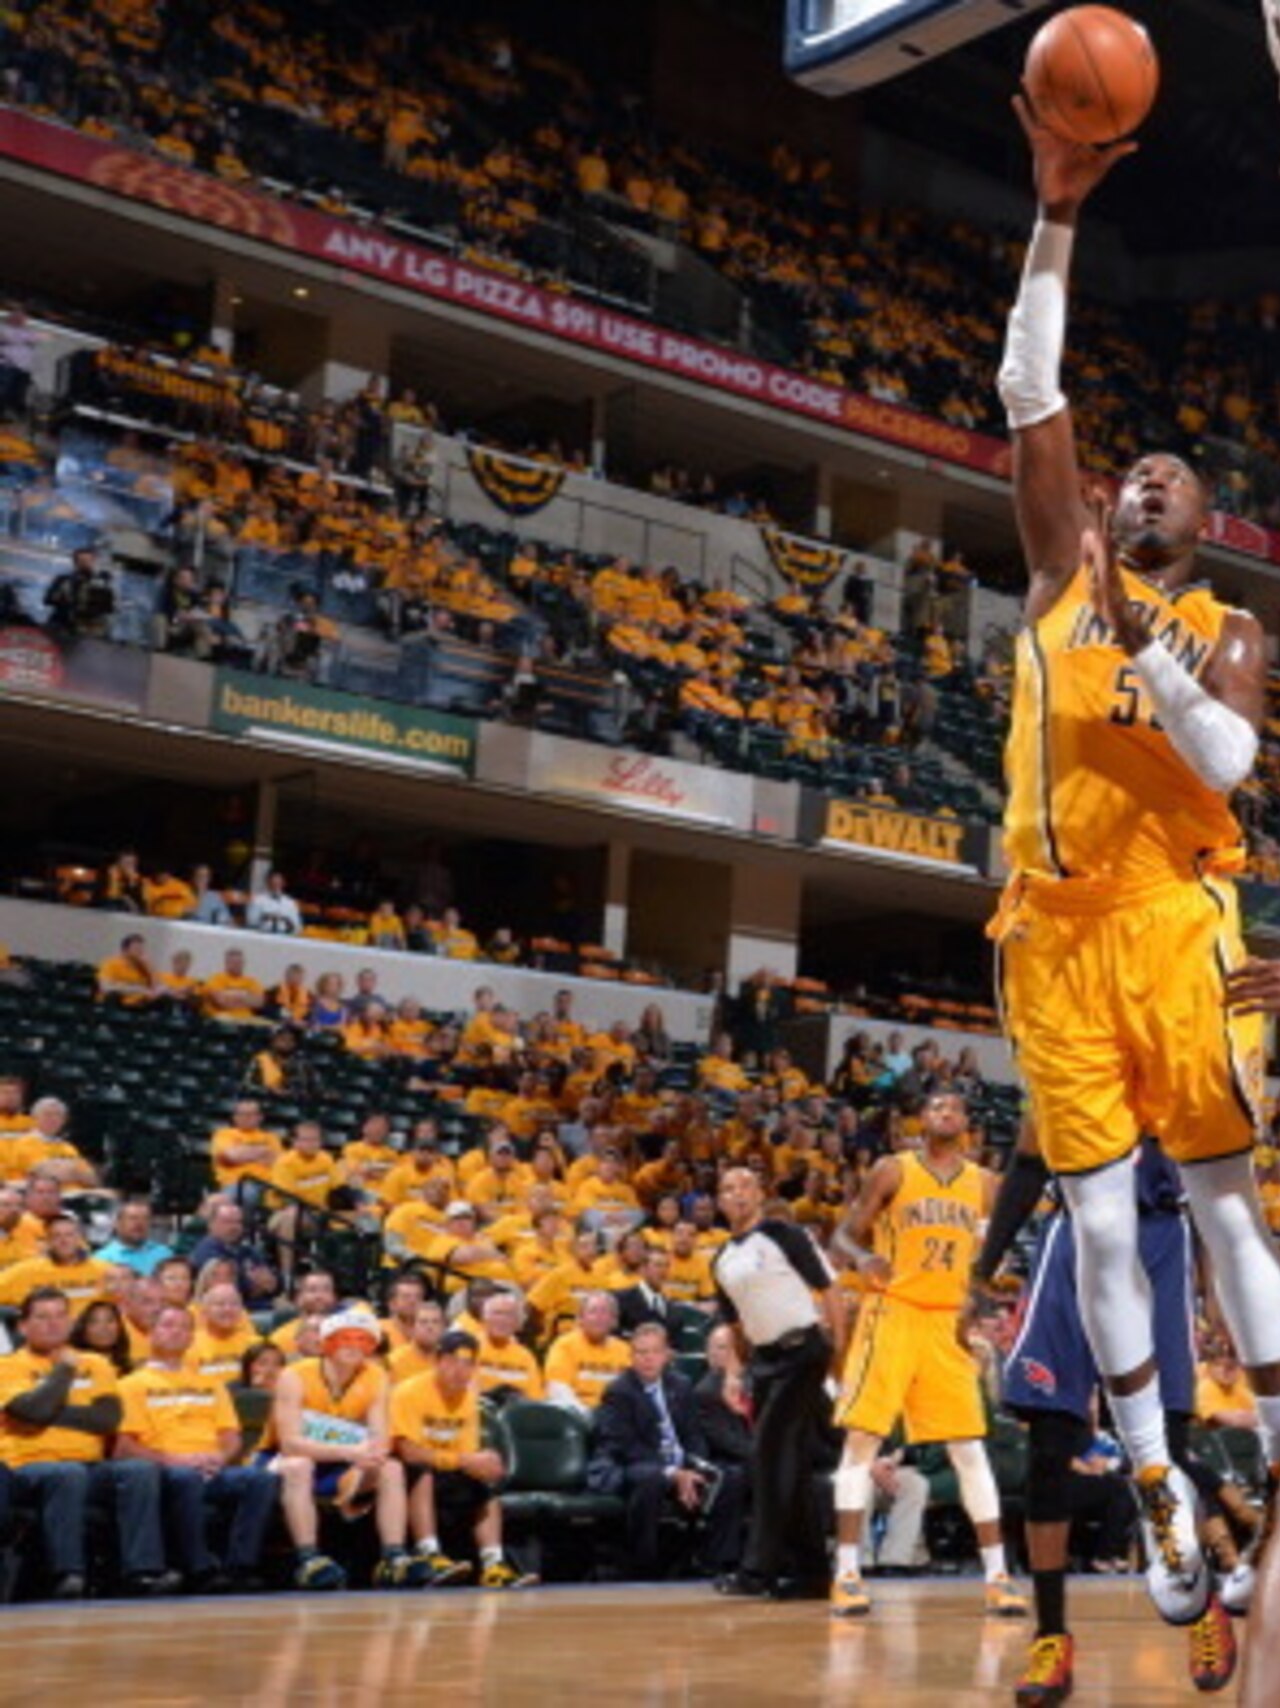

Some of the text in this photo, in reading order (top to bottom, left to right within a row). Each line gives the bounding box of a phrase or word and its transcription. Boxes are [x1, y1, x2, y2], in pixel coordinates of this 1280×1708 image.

[324, 230, 399, 270] ANY
[404, 253, 447, 286] LG
[453, 269, 546, 319] PIZZA
[602, 315, 657, 356] USE
[661, 337, 764, 390] PROMO
[768, 371, 843, 417] CODE
[221, 682, 471, 759] bankerslife.com
[601, 754, 686, 808] Lilly
[920, 1236, 957, 1273] 24
